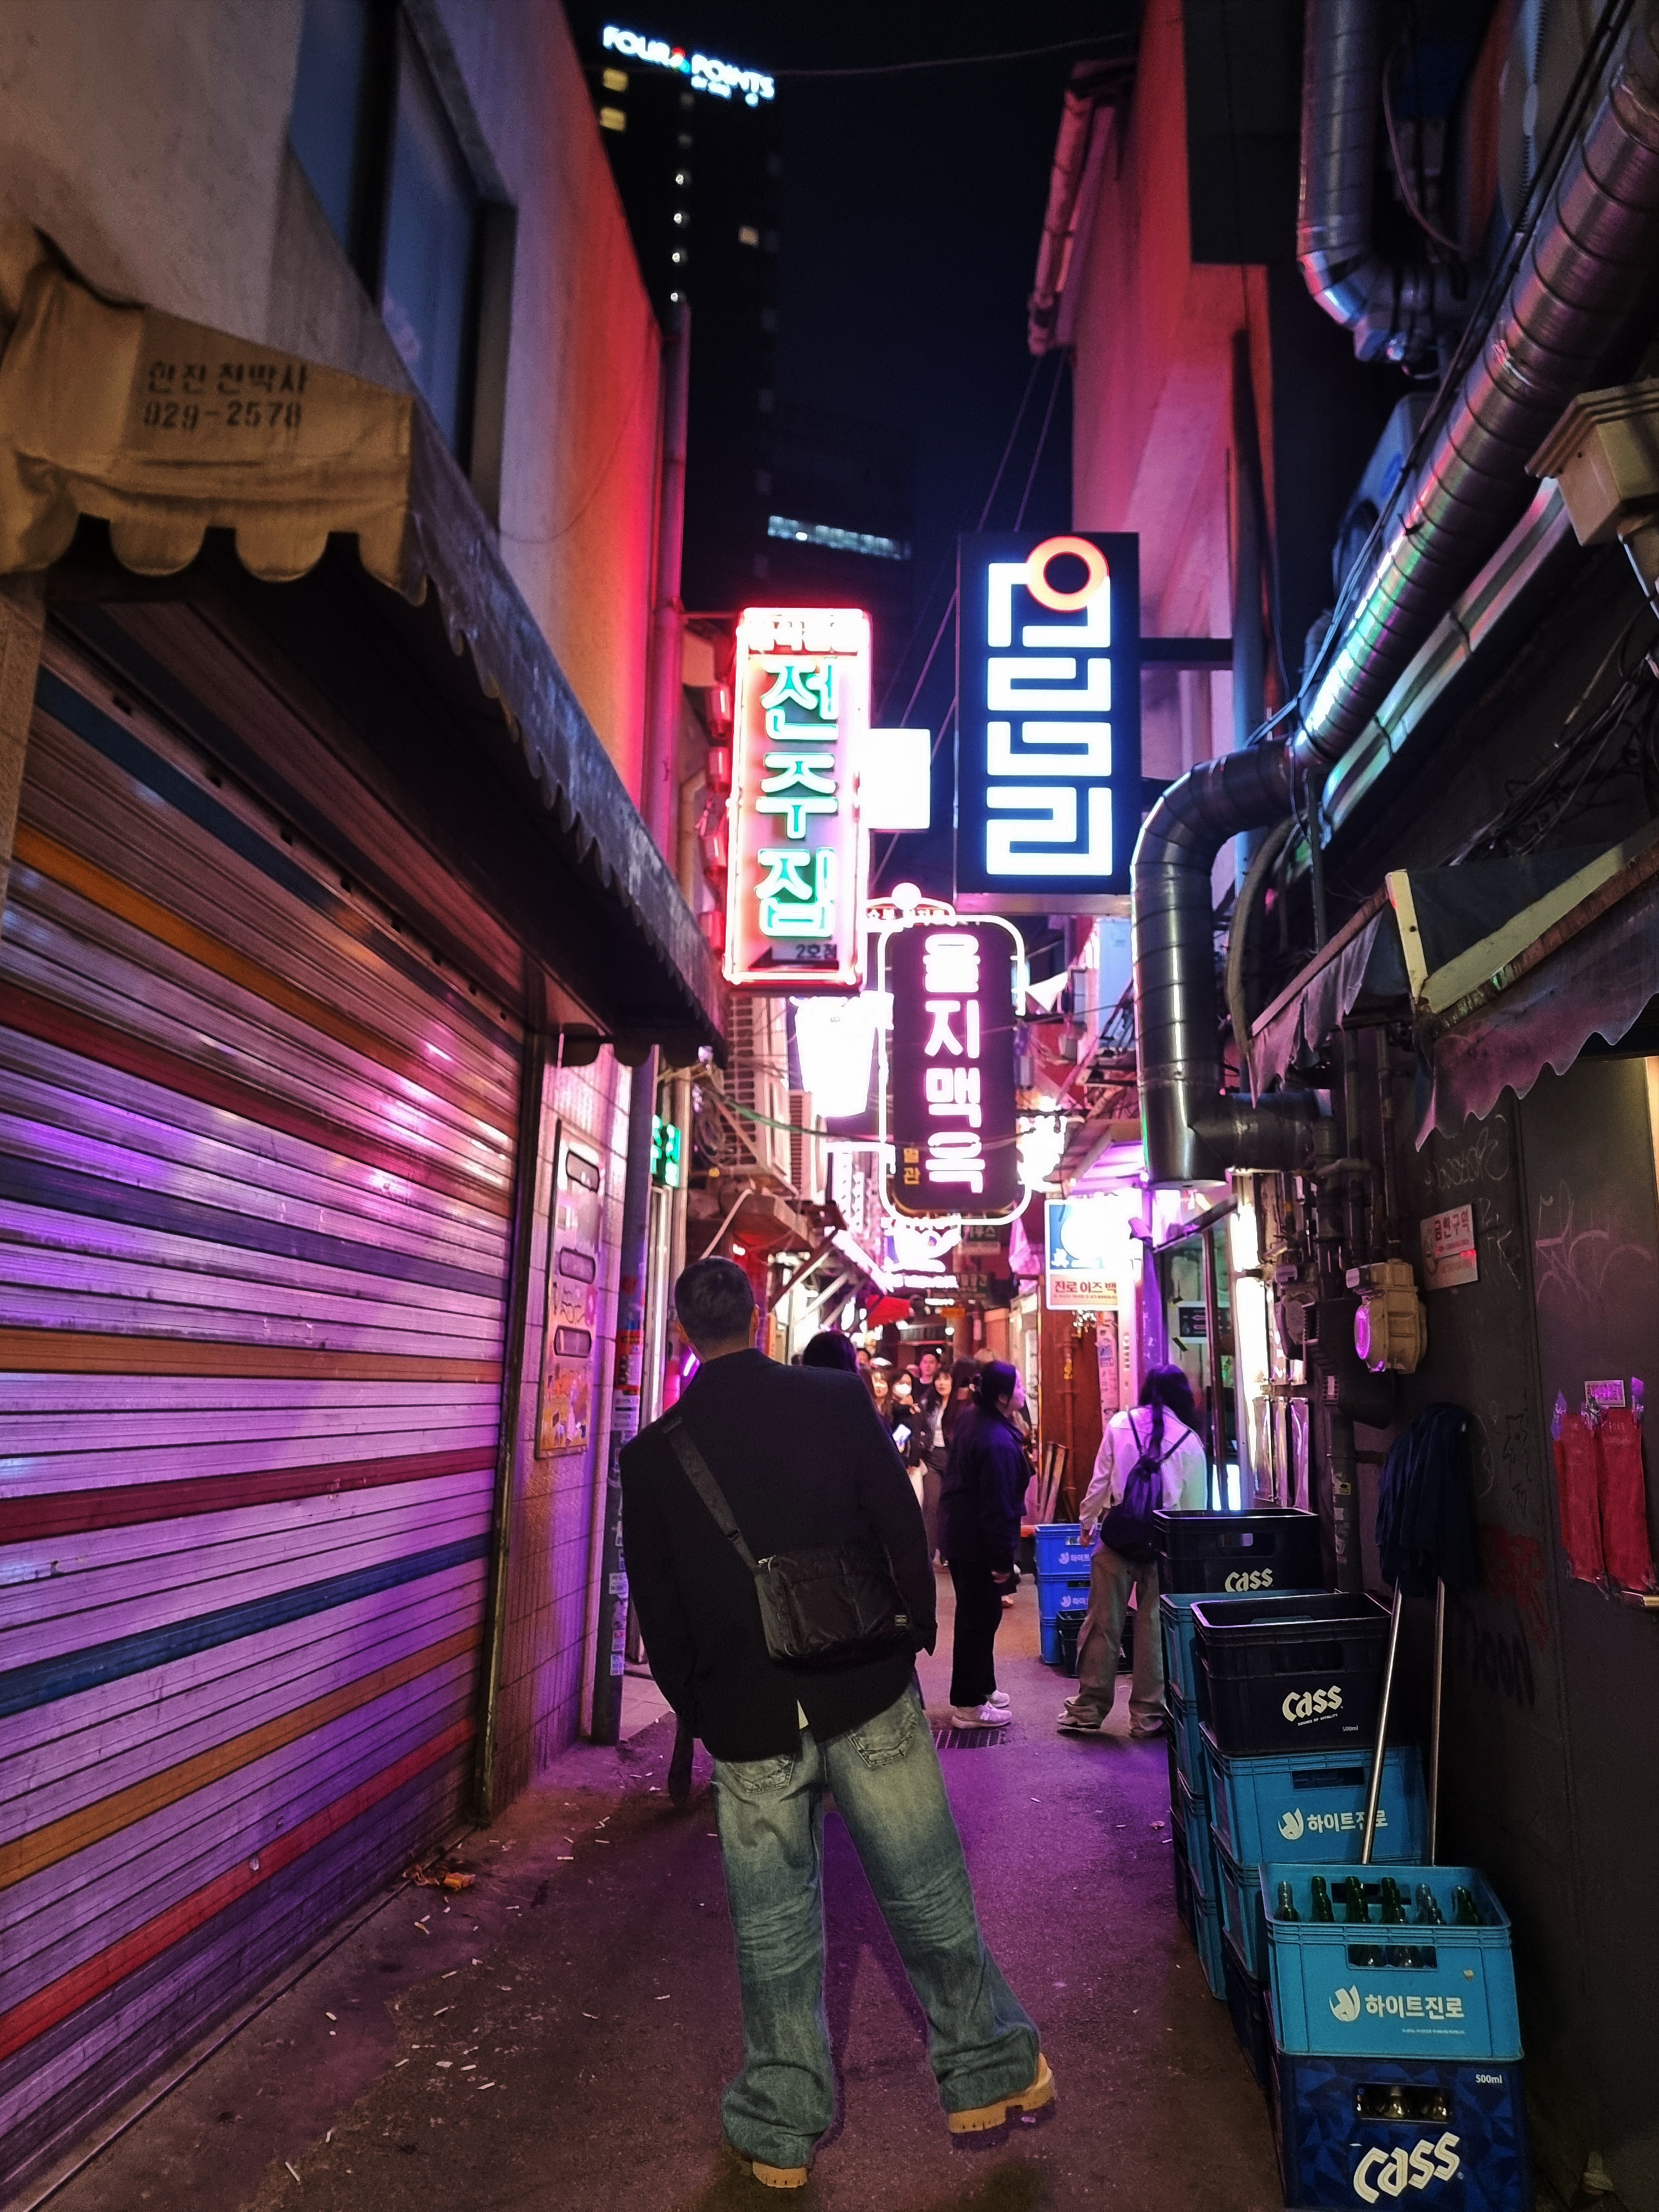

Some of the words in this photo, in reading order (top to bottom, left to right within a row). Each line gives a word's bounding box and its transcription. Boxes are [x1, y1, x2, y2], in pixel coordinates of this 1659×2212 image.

[754, 656, 839, 938] 전주집
[1055, 1281, 1078, 1293] 진로
[1079, 1281, 1103, 1293] 이즈
[1104, 1281, 1117, 1294] 백
[1224, 1568, 1274, 1593] Cass
[1282, 1685, 1343, 1722] Cass
[1364, 1994, 1464, 2020] 하이트진로
[1475, 2074, 1503, 2084] 500ml
[1353, 2131, 1461, 2205] Cass
